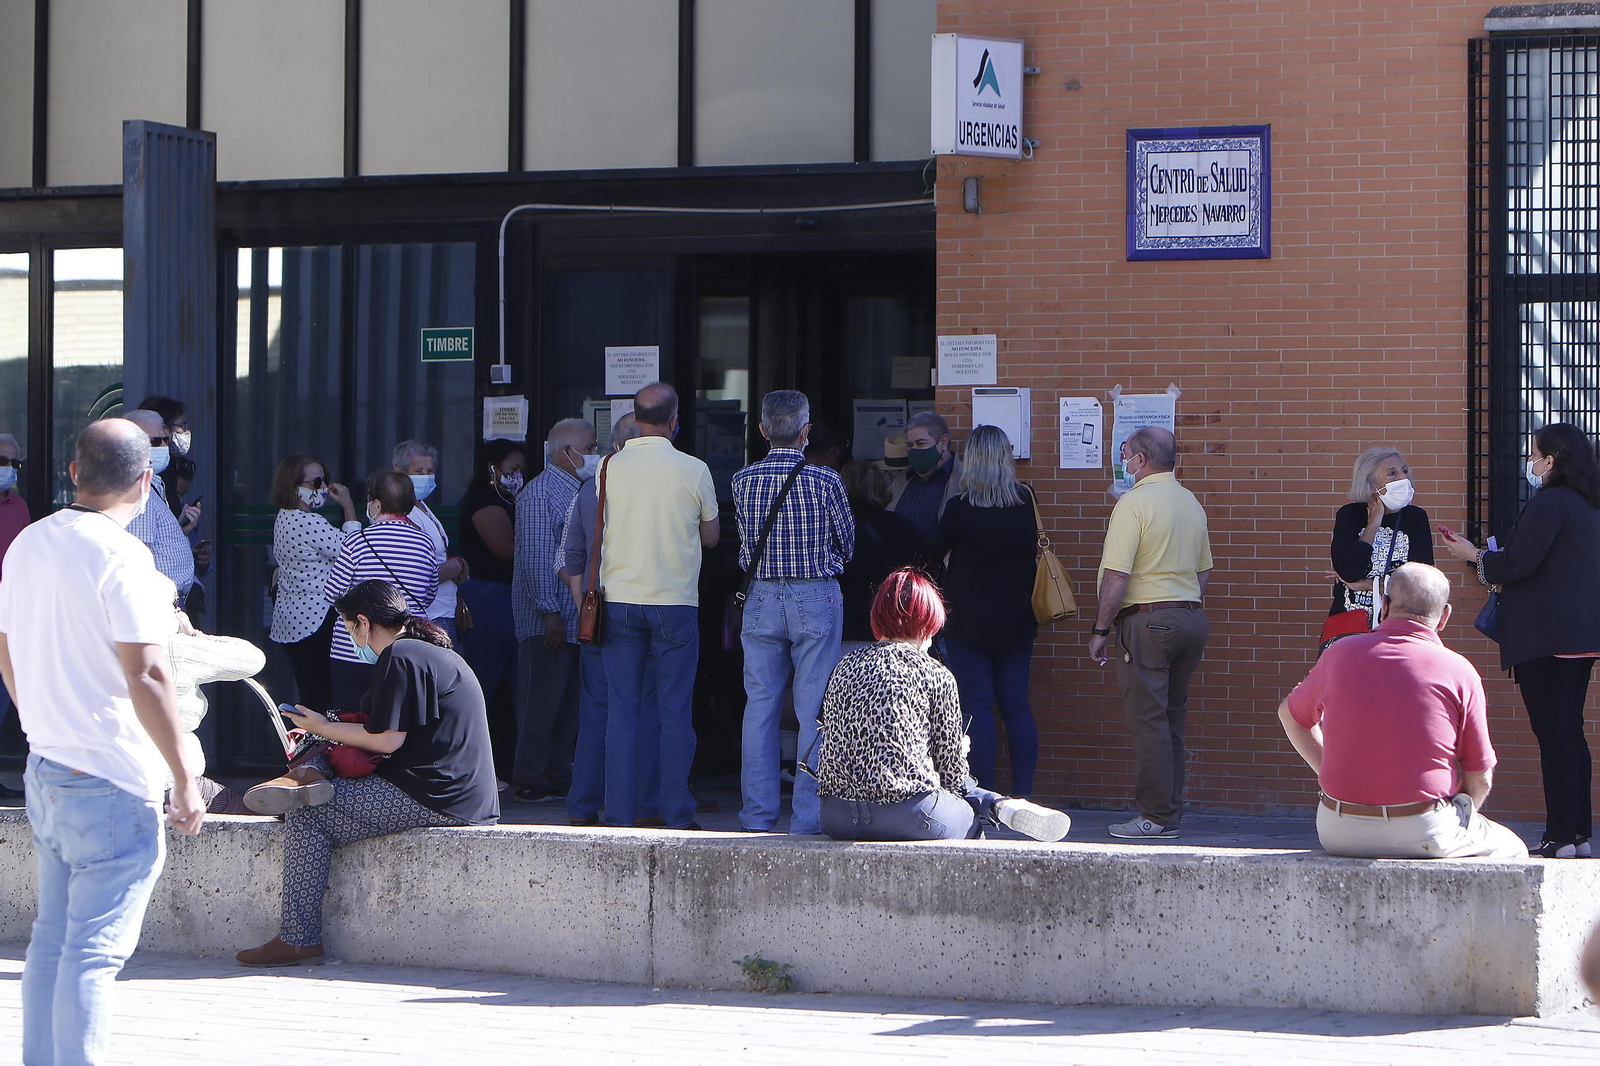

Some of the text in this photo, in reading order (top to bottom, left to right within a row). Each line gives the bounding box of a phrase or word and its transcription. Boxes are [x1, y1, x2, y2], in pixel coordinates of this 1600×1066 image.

[960, 120, 1018, 148] URGENCIAS
[1150, 163, 1194, 194] CENTRO
[1210, 160, 1247, 193] SALUD
[1150, 204, 1246, 226] MERCEDES NAVARRO
[426, 337, 468, 351] TIMBRE
